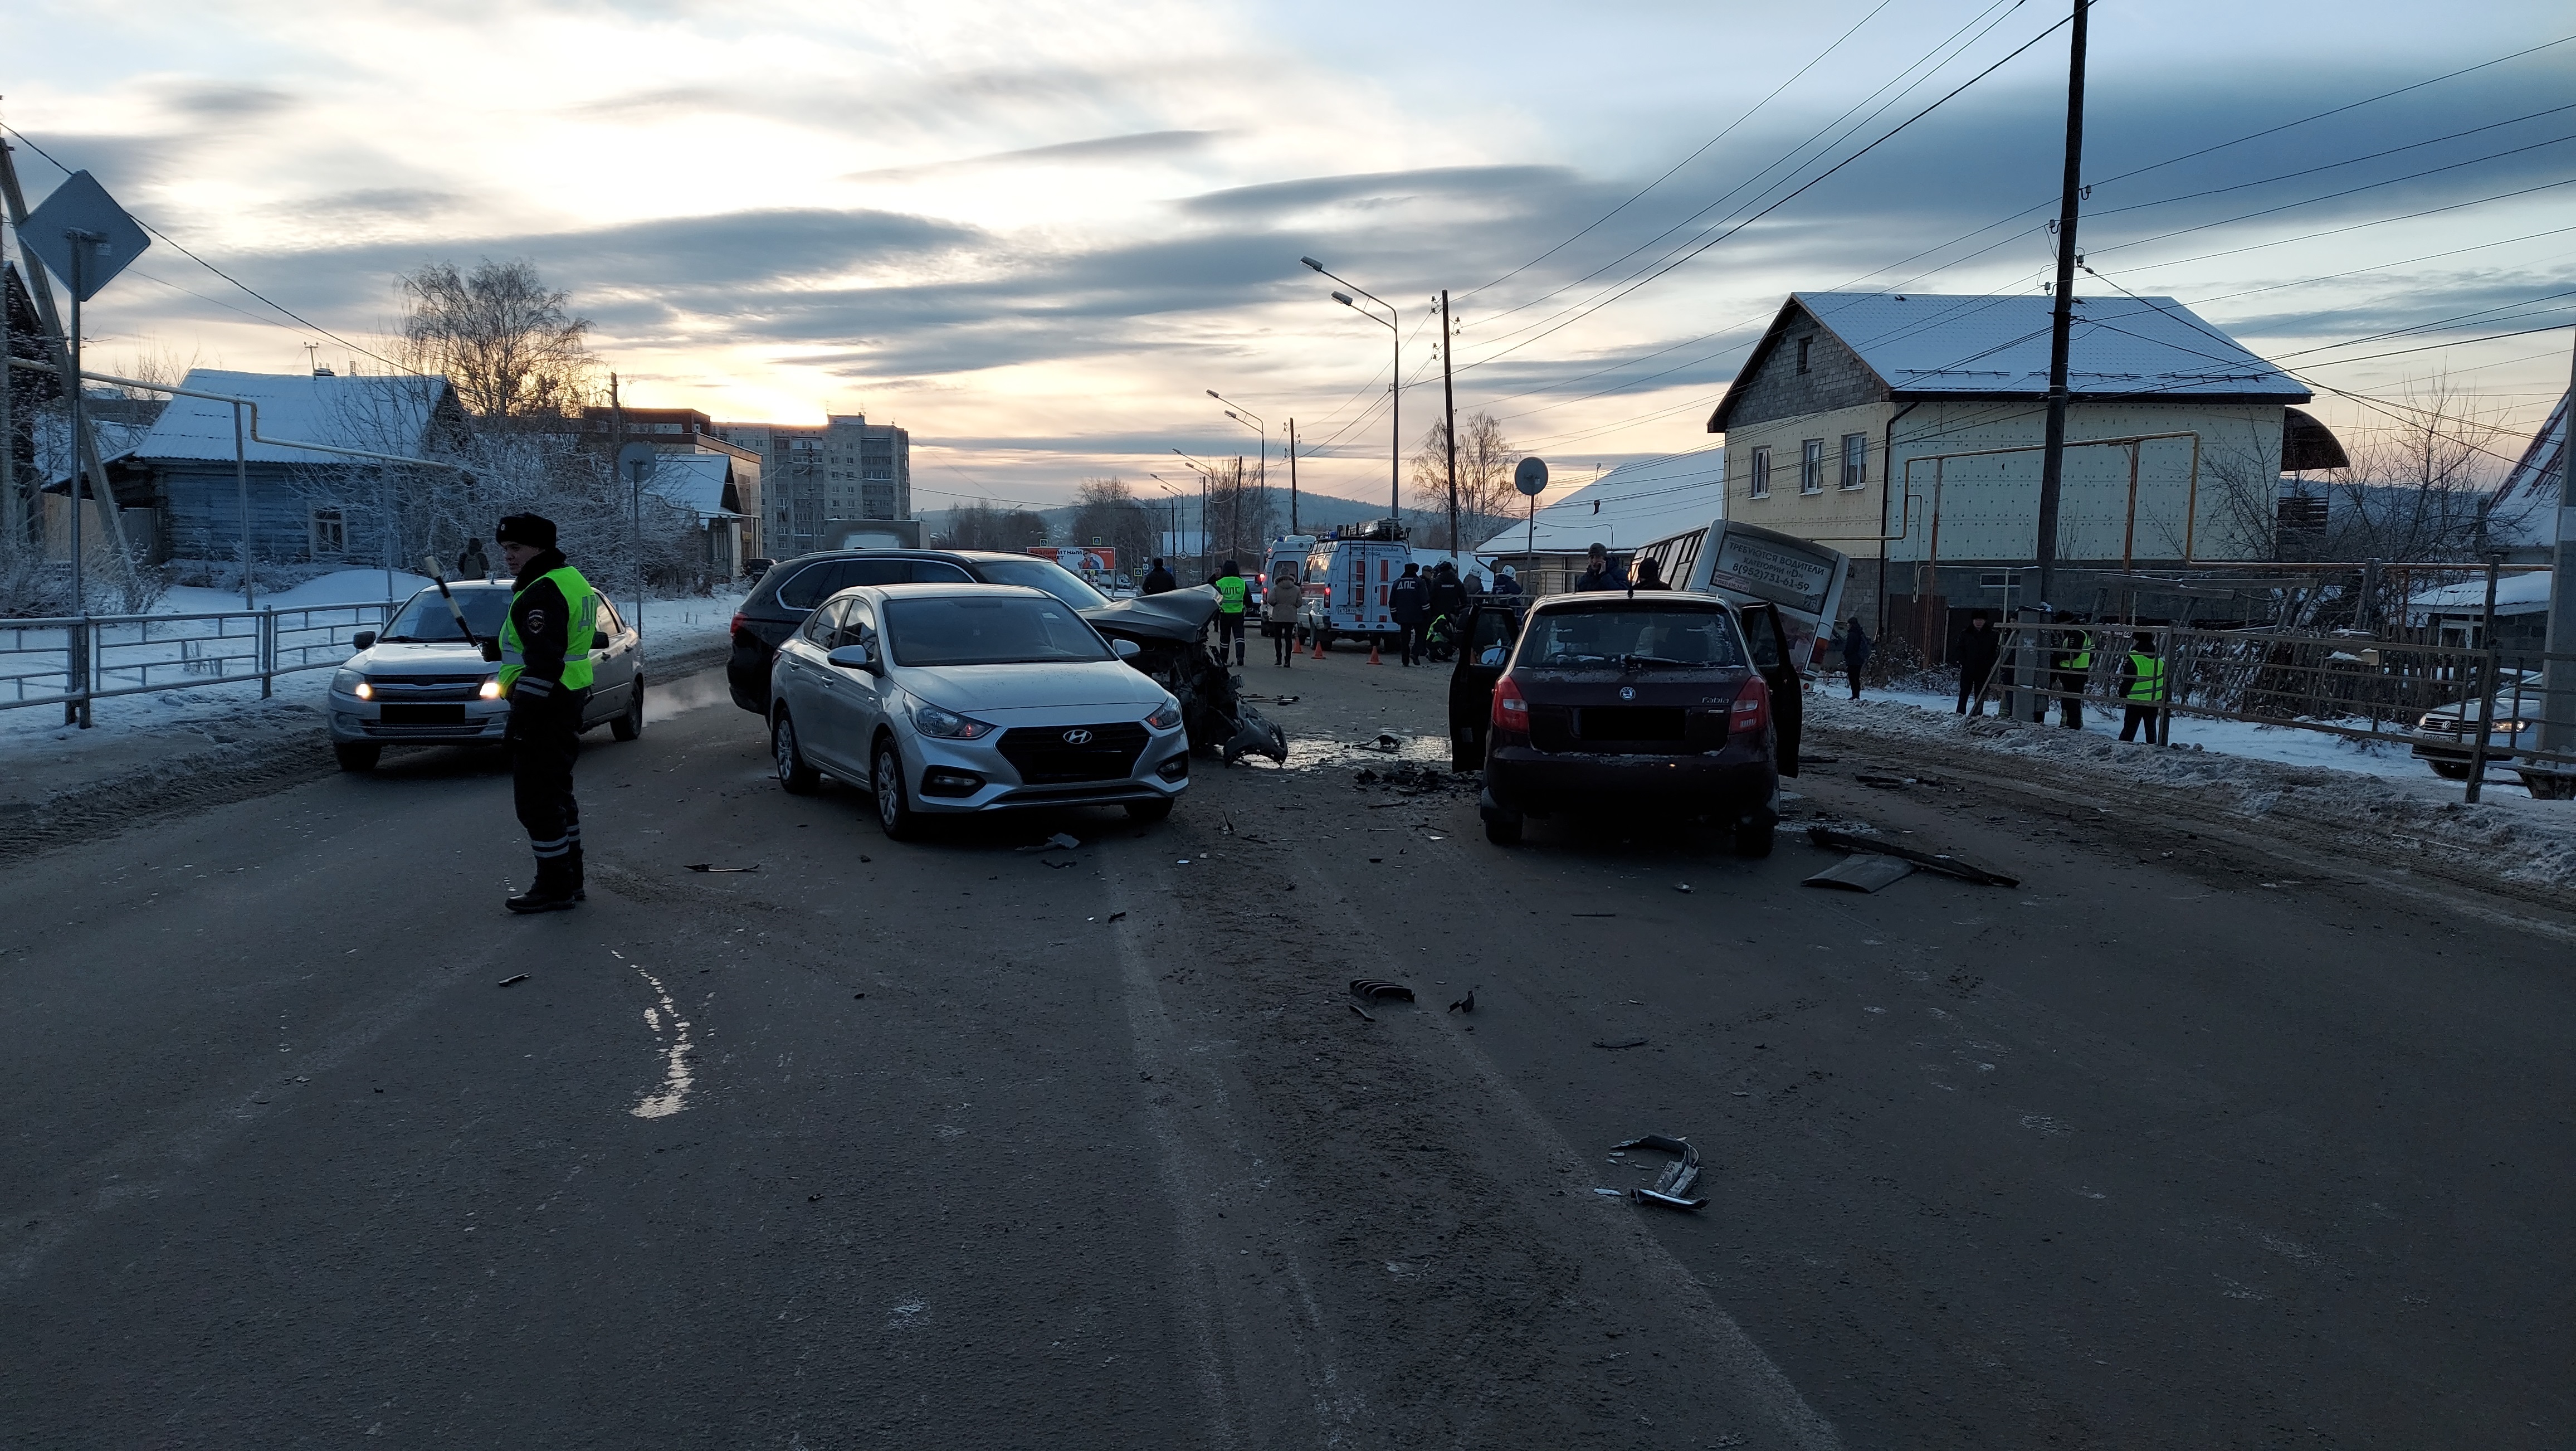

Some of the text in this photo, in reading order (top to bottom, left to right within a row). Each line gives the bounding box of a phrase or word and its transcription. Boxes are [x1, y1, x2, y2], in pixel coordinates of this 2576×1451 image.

[1729, 542, 1825, 576] ТРЕБУЮТСЯ ВОДИТЕЛИ
[1743, 557, 1785, 574] КАТЕГОРИИ
[1397, 581, 1416, 590] ДПС
[1732, 563, 1809, 591] 8(952)731-61-59
[1221, 586, 1241, 595] ДПС
[577, 595, 597, 632] ДП
